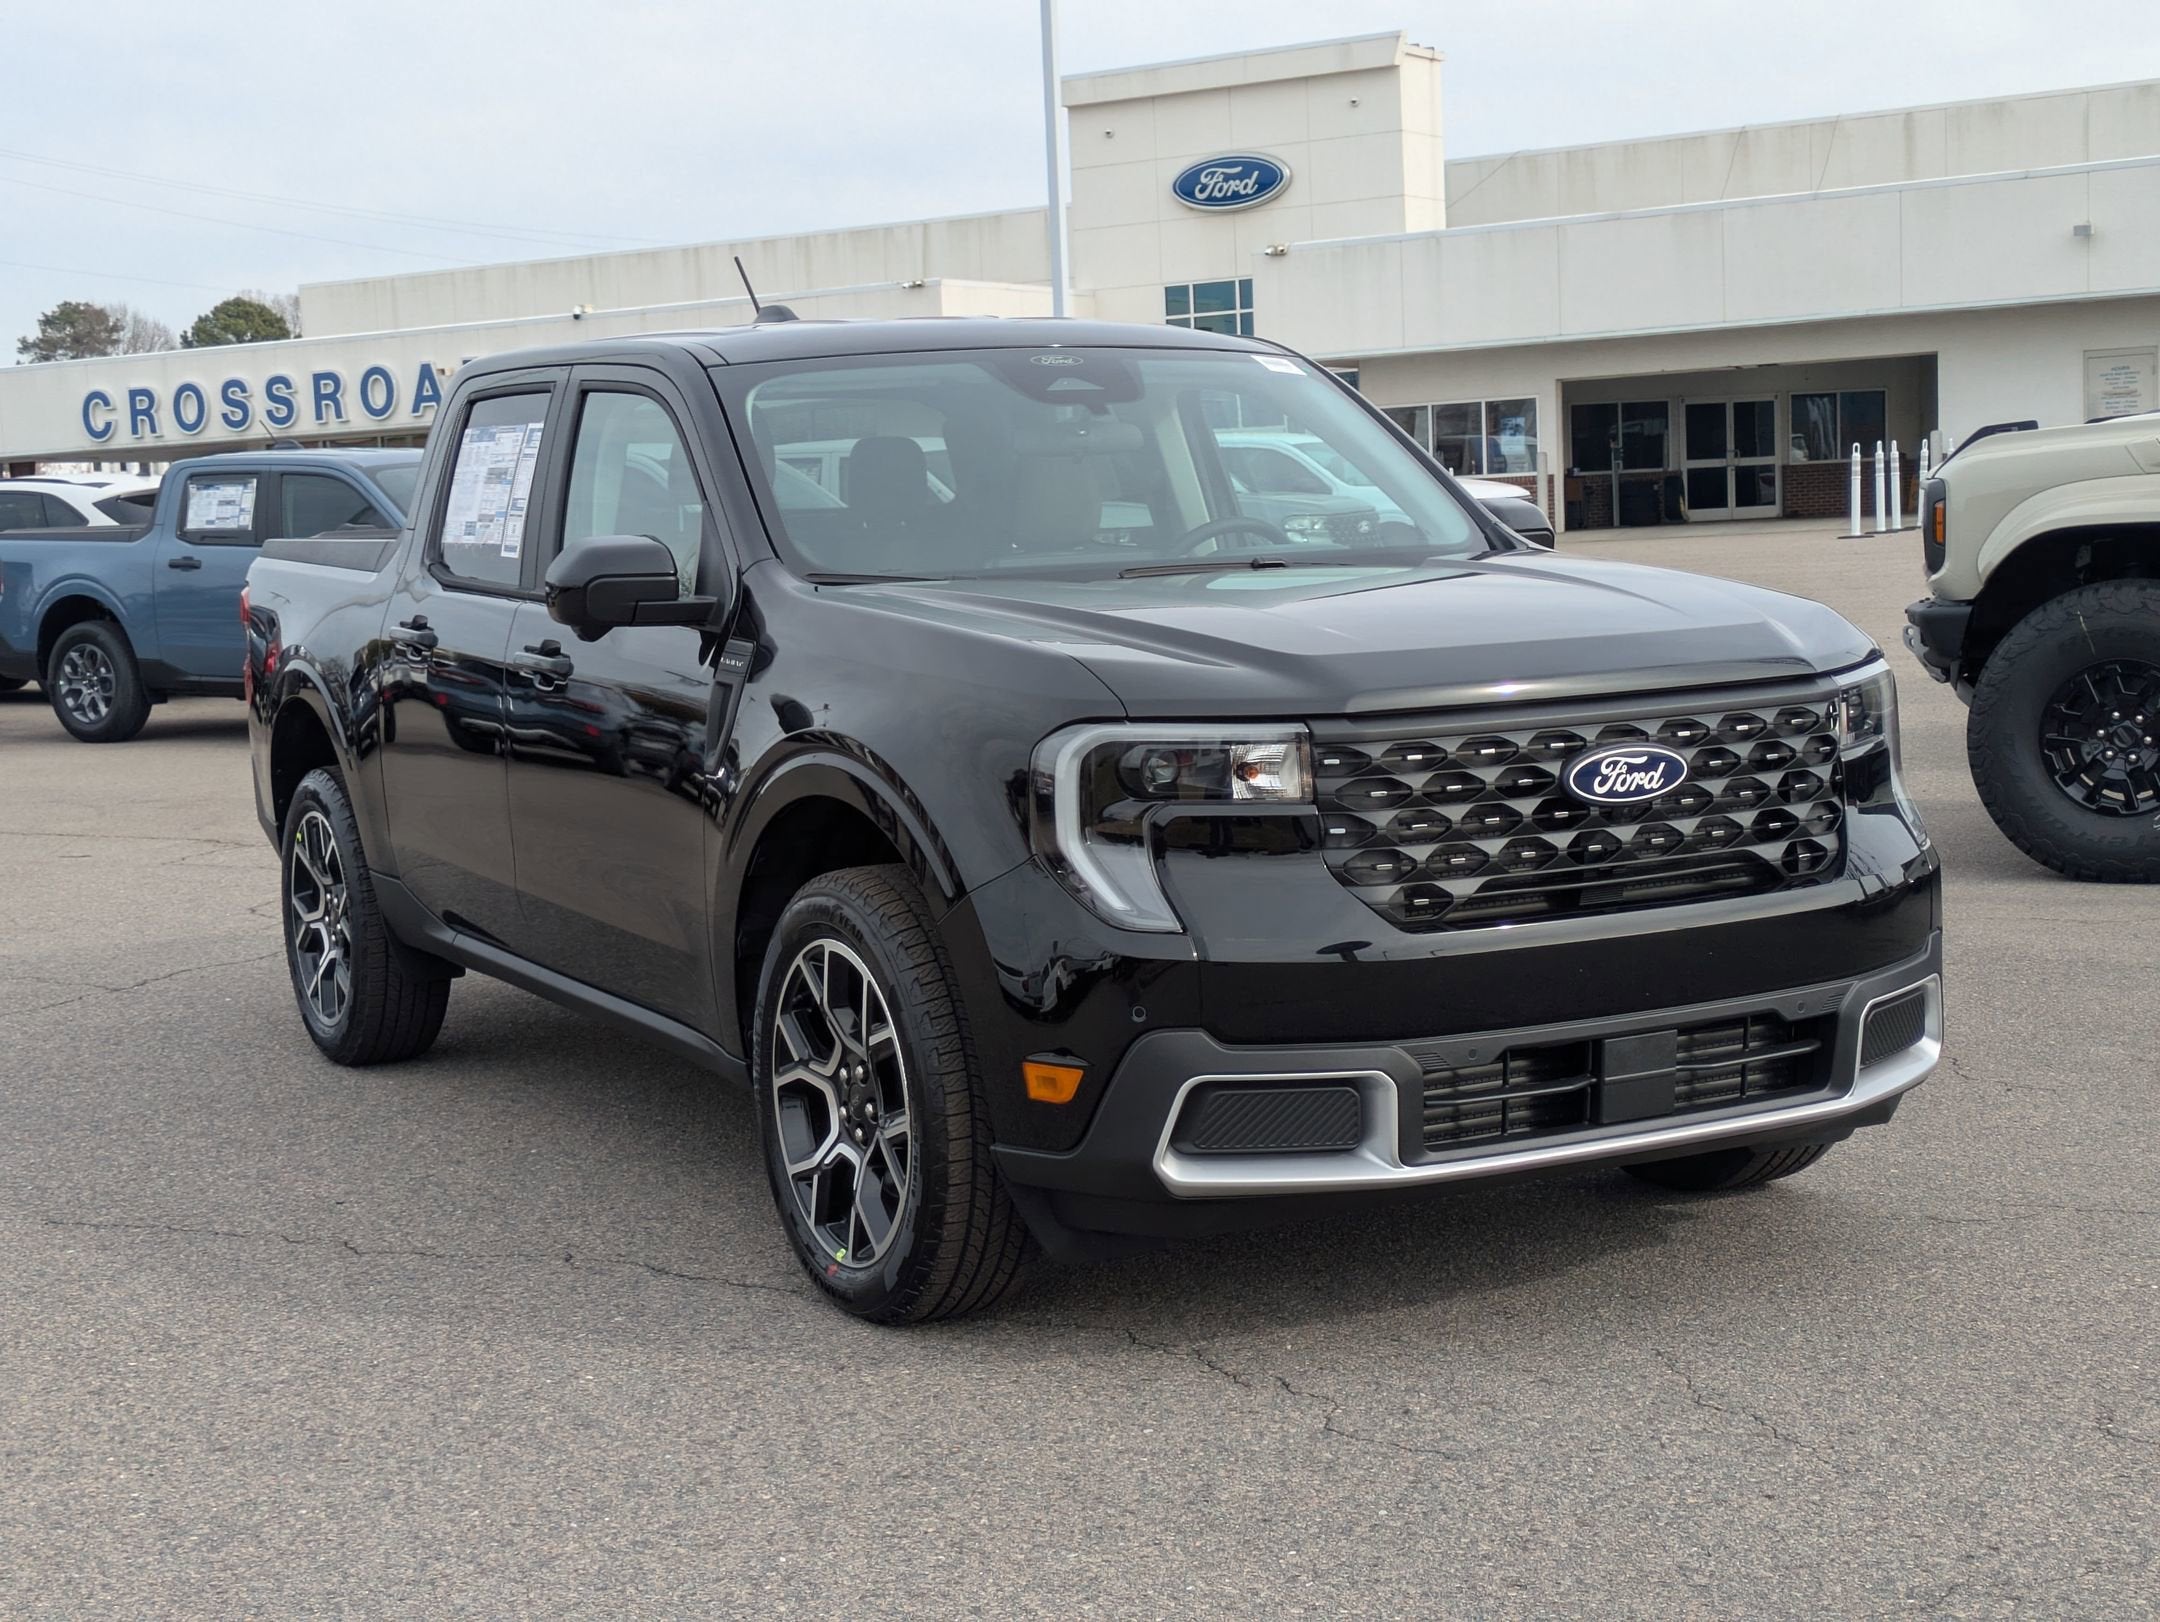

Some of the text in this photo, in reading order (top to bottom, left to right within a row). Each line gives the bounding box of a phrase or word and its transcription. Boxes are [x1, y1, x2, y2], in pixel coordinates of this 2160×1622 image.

[1194, 166, 1260, 200] Ford
[1040, 355, 1075, 365] Ford
[81, 357, 477, 443] CROSSROA
[1593, 755, 1666, 795] Ford
